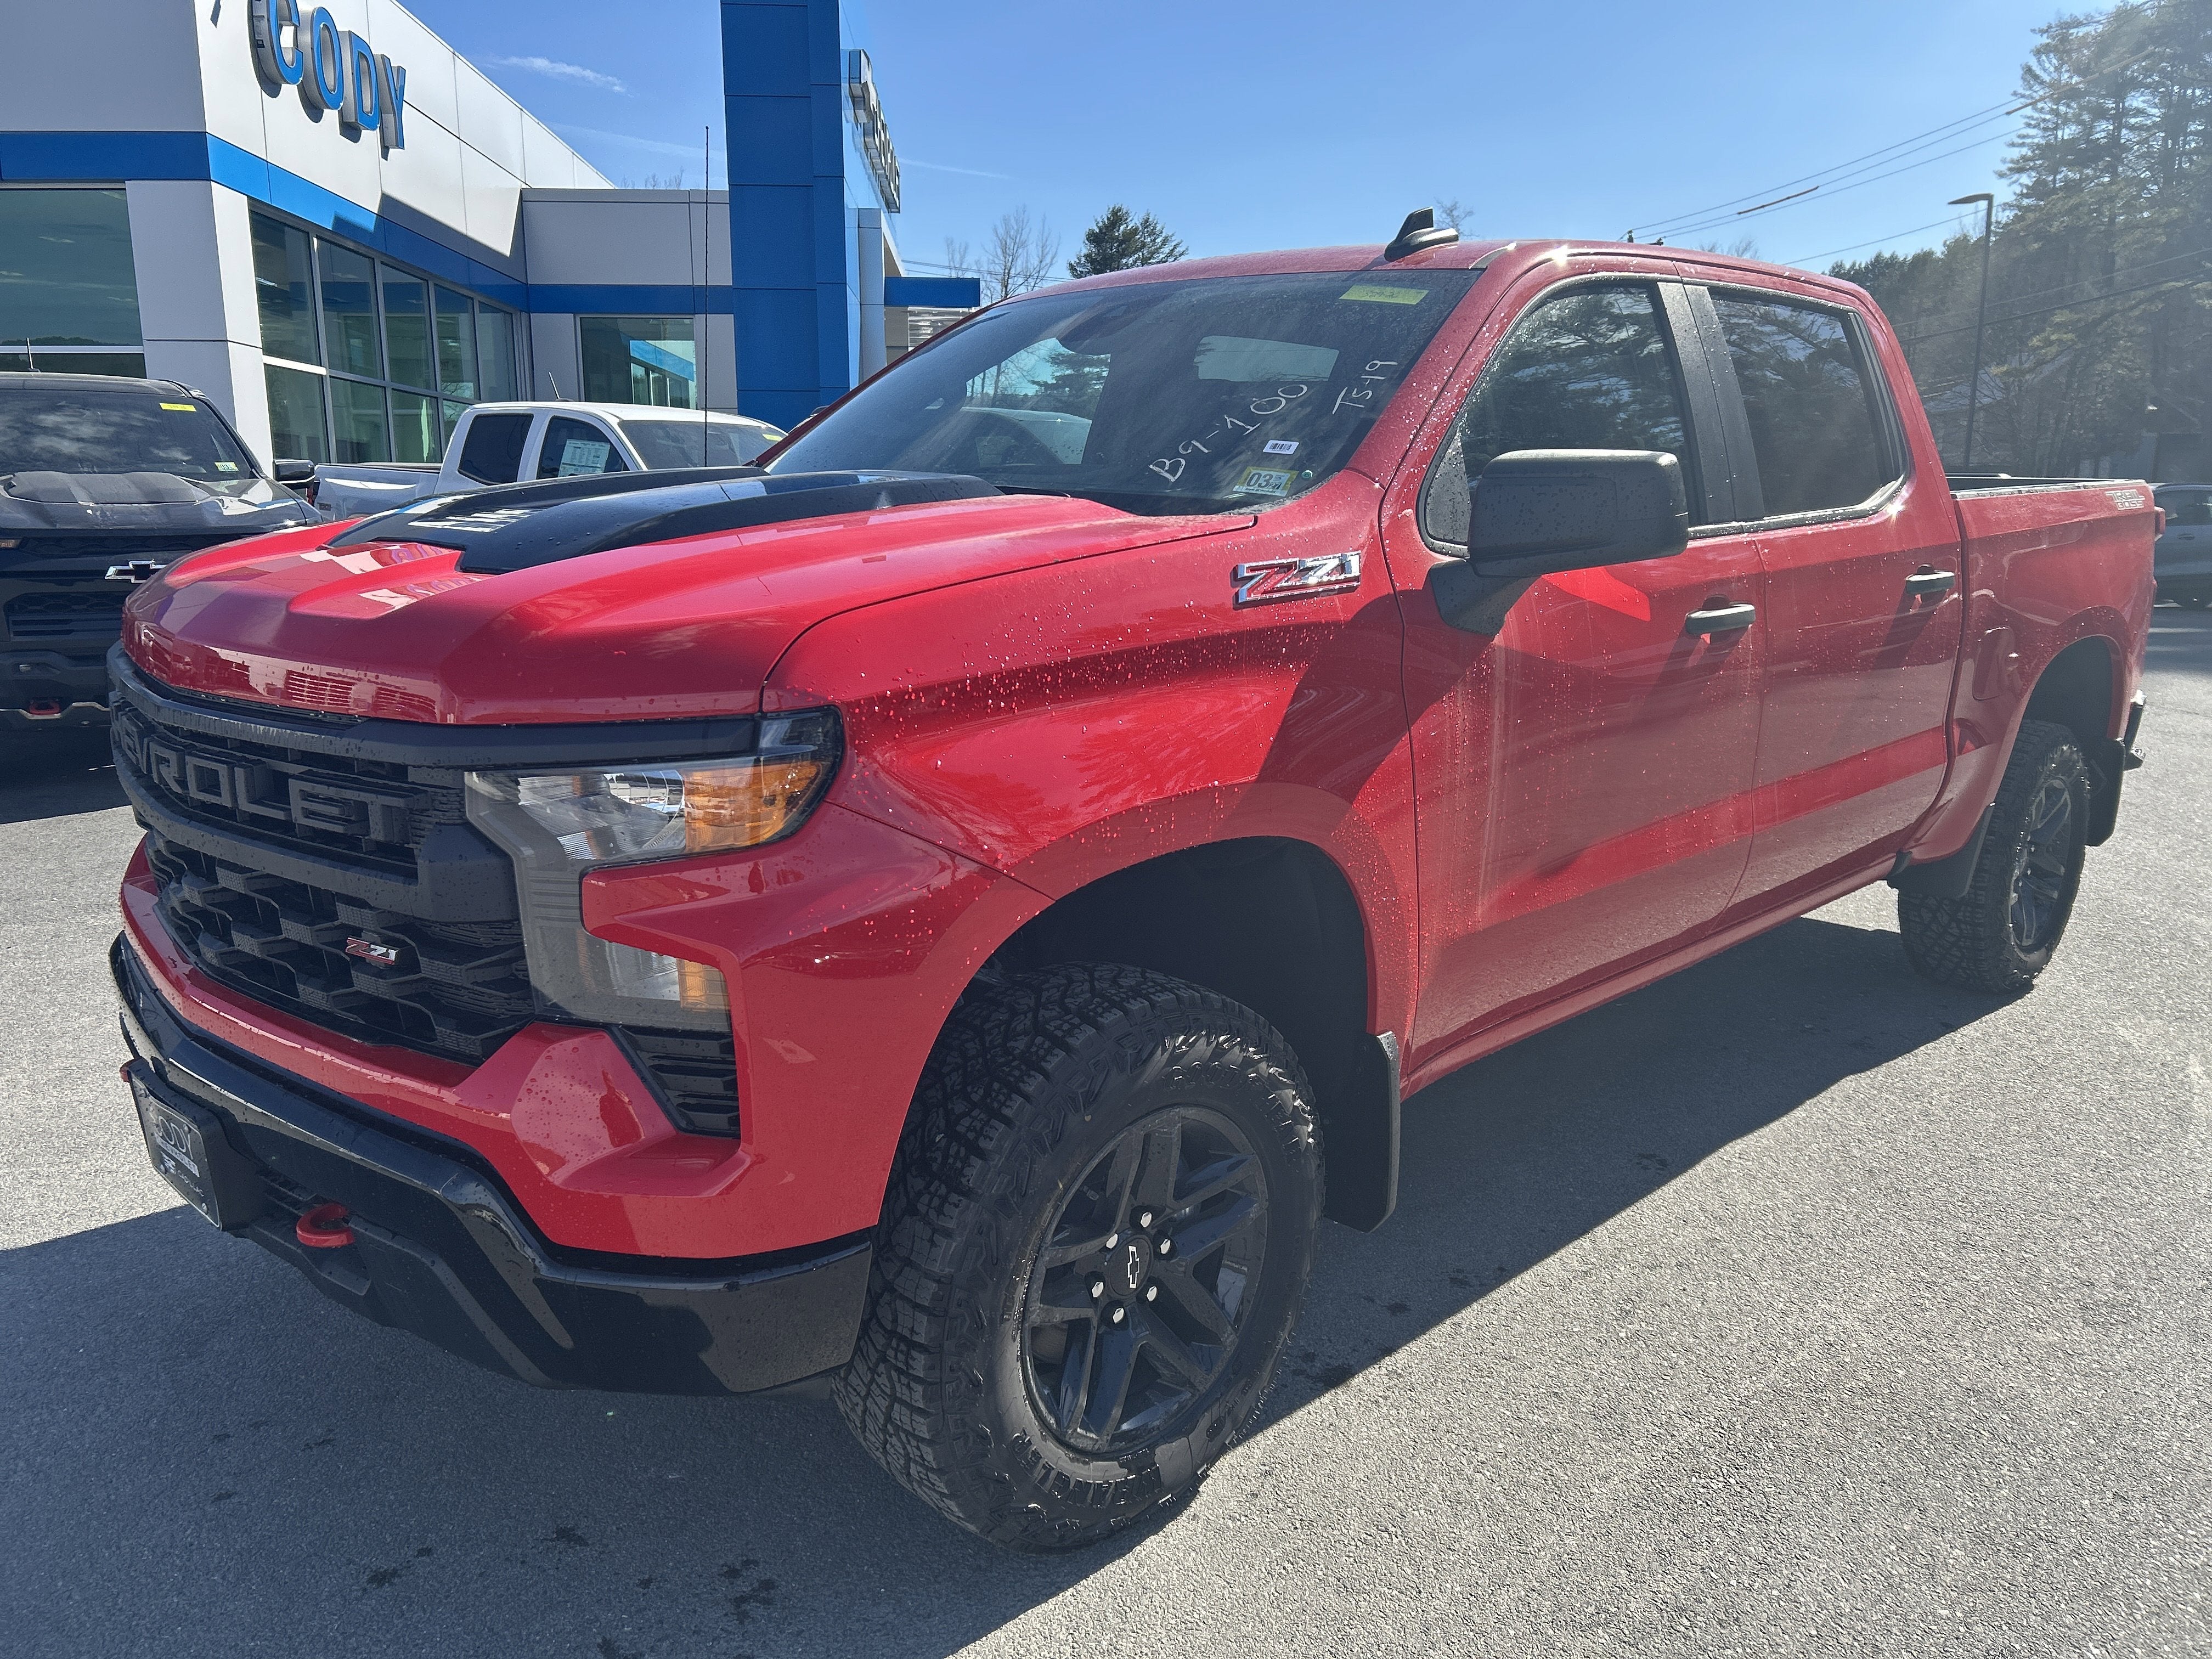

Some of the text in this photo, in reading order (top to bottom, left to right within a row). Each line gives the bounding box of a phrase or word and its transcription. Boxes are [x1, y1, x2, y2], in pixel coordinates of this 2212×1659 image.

[266, 0, 407, 150] CODY
[1148, 384, 1308, 482] B9-100
[1246, 472, 1273, 488] 03
[2105, 489, 2145, 501] TRAIL
[2117, 500, 2144, 510] BOSS
[1238, 550, 1362, 603] Z71
[346, 937, 398, 964] Z71
